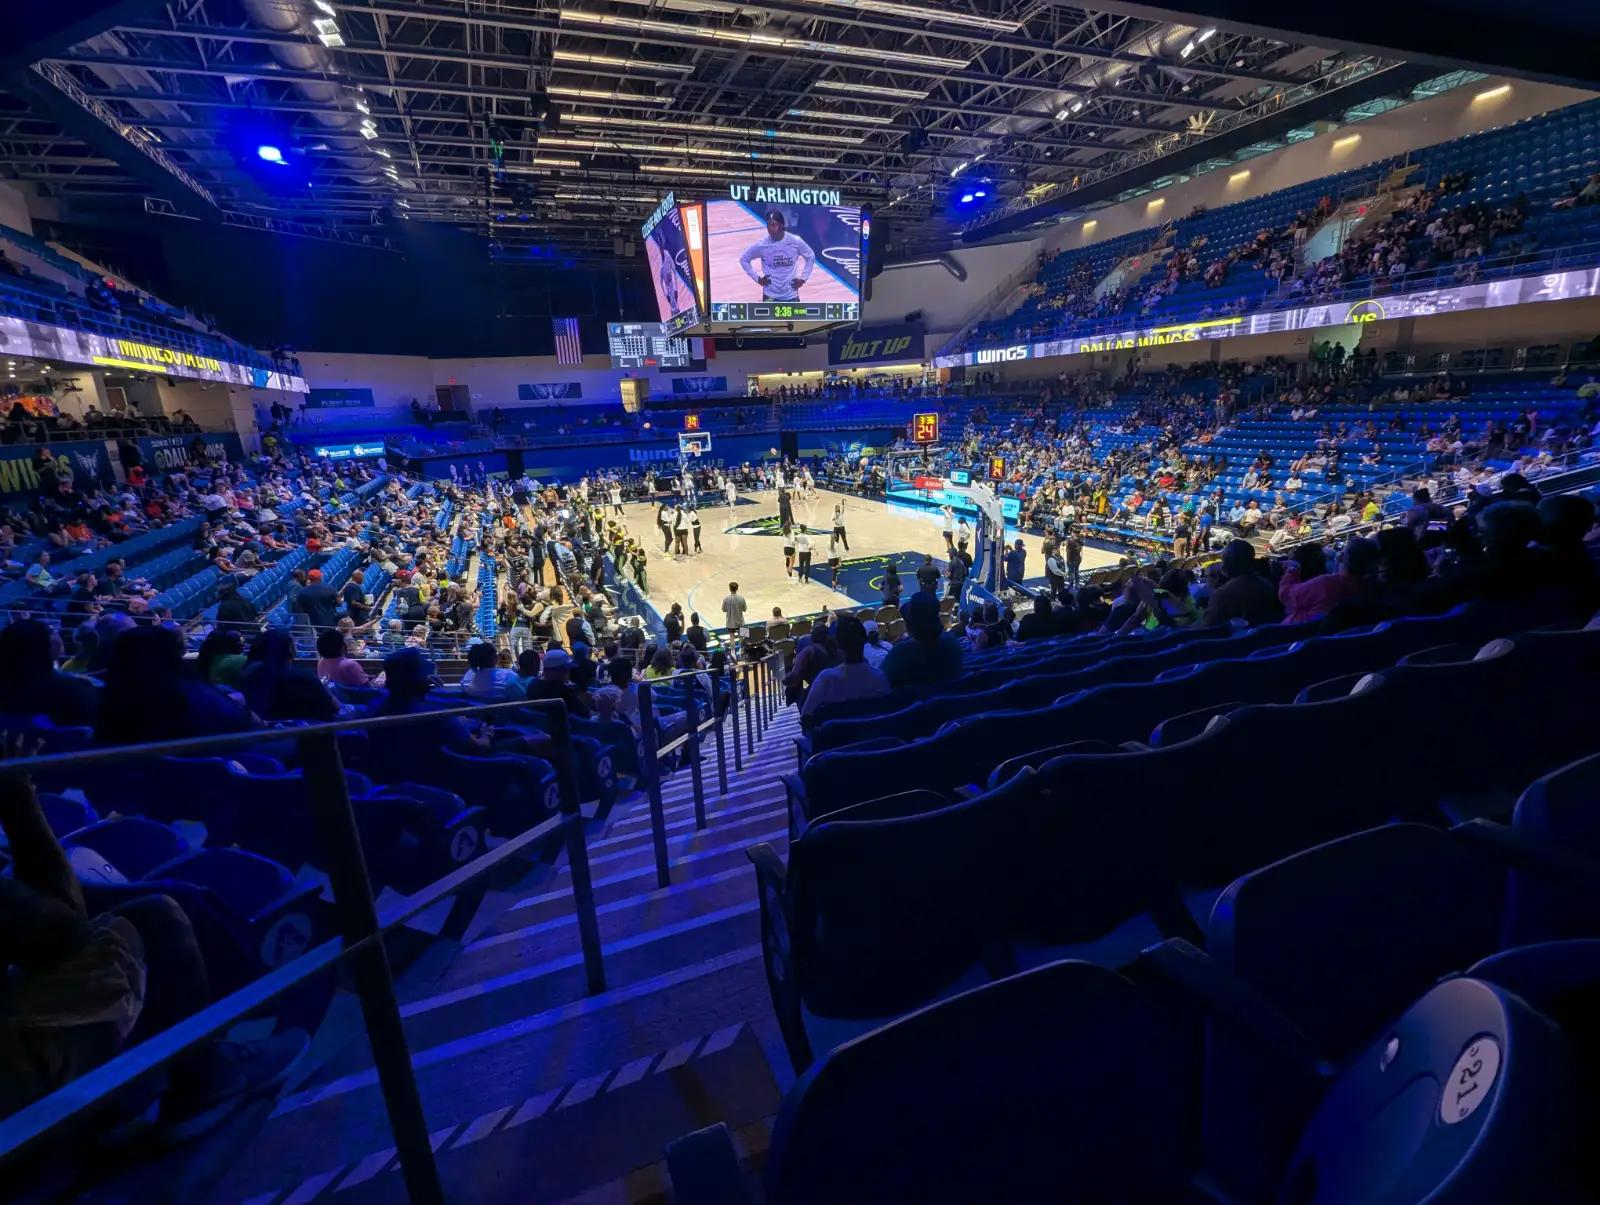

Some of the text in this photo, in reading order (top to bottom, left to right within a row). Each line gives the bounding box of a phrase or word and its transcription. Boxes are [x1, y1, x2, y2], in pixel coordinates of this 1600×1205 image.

[730, 184, 840, 206] UT ARLINGTON
[774, 306, 793, 318] 3:36
[840, 331, 912, 361] VOLT UP
[1080, 338, 1135, 353] DALLAS
[1138, 331, 1196, 347] WINGS
[977, 345, 1029, 364] WINGS
[918, 425, 934, 439] 24
[629, 447, 691, 461] WING
[969, 594, 985, 605] WNB
[1456, 1059, 1483, 1105] 21
